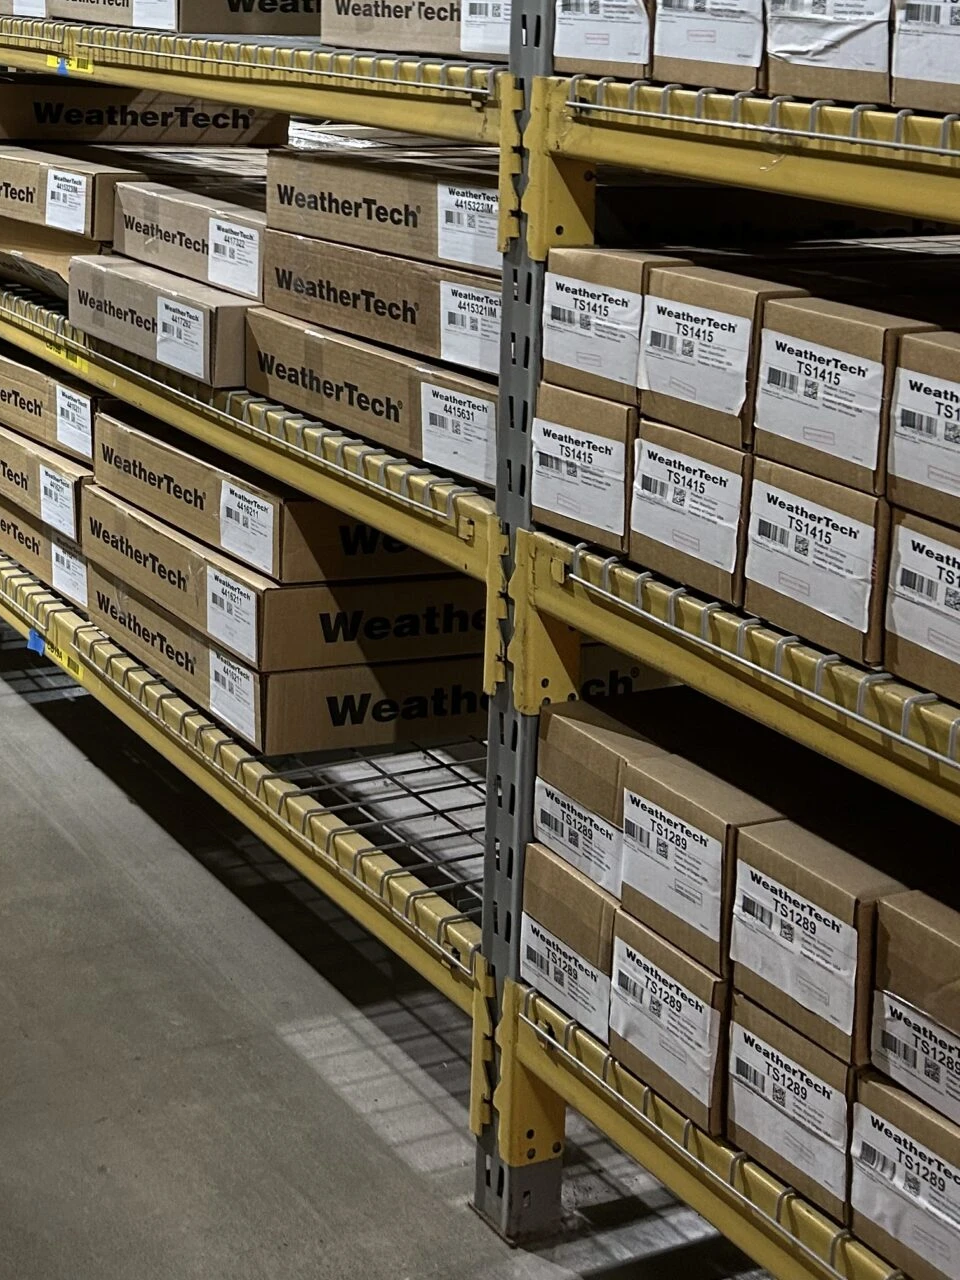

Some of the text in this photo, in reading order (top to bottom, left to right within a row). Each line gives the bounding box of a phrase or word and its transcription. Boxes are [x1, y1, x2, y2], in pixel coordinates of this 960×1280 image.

[34, 101, 251, 129] WeatherTech
[53, 174, 81, 186] WeatherTech
[277, 184, 418, 228] WeatherTech
[124, 214, 208, 255] WeatherTech
[216, 224, 254, 241] WeatherTech
[78, 288, 157, 333] WeatherTech
[164, 304, 199, 321] WeatherTech
[276, 268, 416, 325] WeatherTech
[556, 281, 628, 308] WeatherTech
[573, 297, 609, 317] TS1415
[656, 305, 736, 333] WeatherTech
[675, 322, 714, 343] TS1415
[775, 340, 866, 377] WeatherTech
[796, 361, 841, 386] TS1415
[258, 351, 400, 423] WeatherTech
[431, 390, 488, 413] WeatherTech
[444, 403, 474, 422] 4415631
[542, 427, 612, 455] WeatherTech
[559, 444, 593, 464] TS1415
[102, 442, 202, 510] WeatherTech
[647, 449, 728, 487] WeatherTech
[667, 469, 705, 494] TS1415
[229, 488, 269, 514] WeatherTech
[766, 492, 859, 539] WeatherTech
[788, 516, 832, 545] TS1415
[89, 516, 187, 592] WeatherTech
[214, 575, 250, 600] WeatherTech
[97, 591, 195, 675] WeatherTech
[544, 789, 613, 841] WeatherTech
[560, 809, 594, 842] TS1289
[629, 794, 707, 847] WeatherTech
[649, 817, 688, 851] TS1289
[749, 870, 840, 933] WeatherTech
[772, 897, 817, 935] TS1289
[530, 923, 597, 982] WeatherTech
[545, 947, 578, 980] TS1289
[625, 946, 703, 1014] WeatherTech
[644, 977, 683, 1013] TS1289
[742, 1032, 831, 1100] WeatherTech
[764, 1061, 808, 1100] TS1289
[896, 1147, 945, 1192] TS1289
